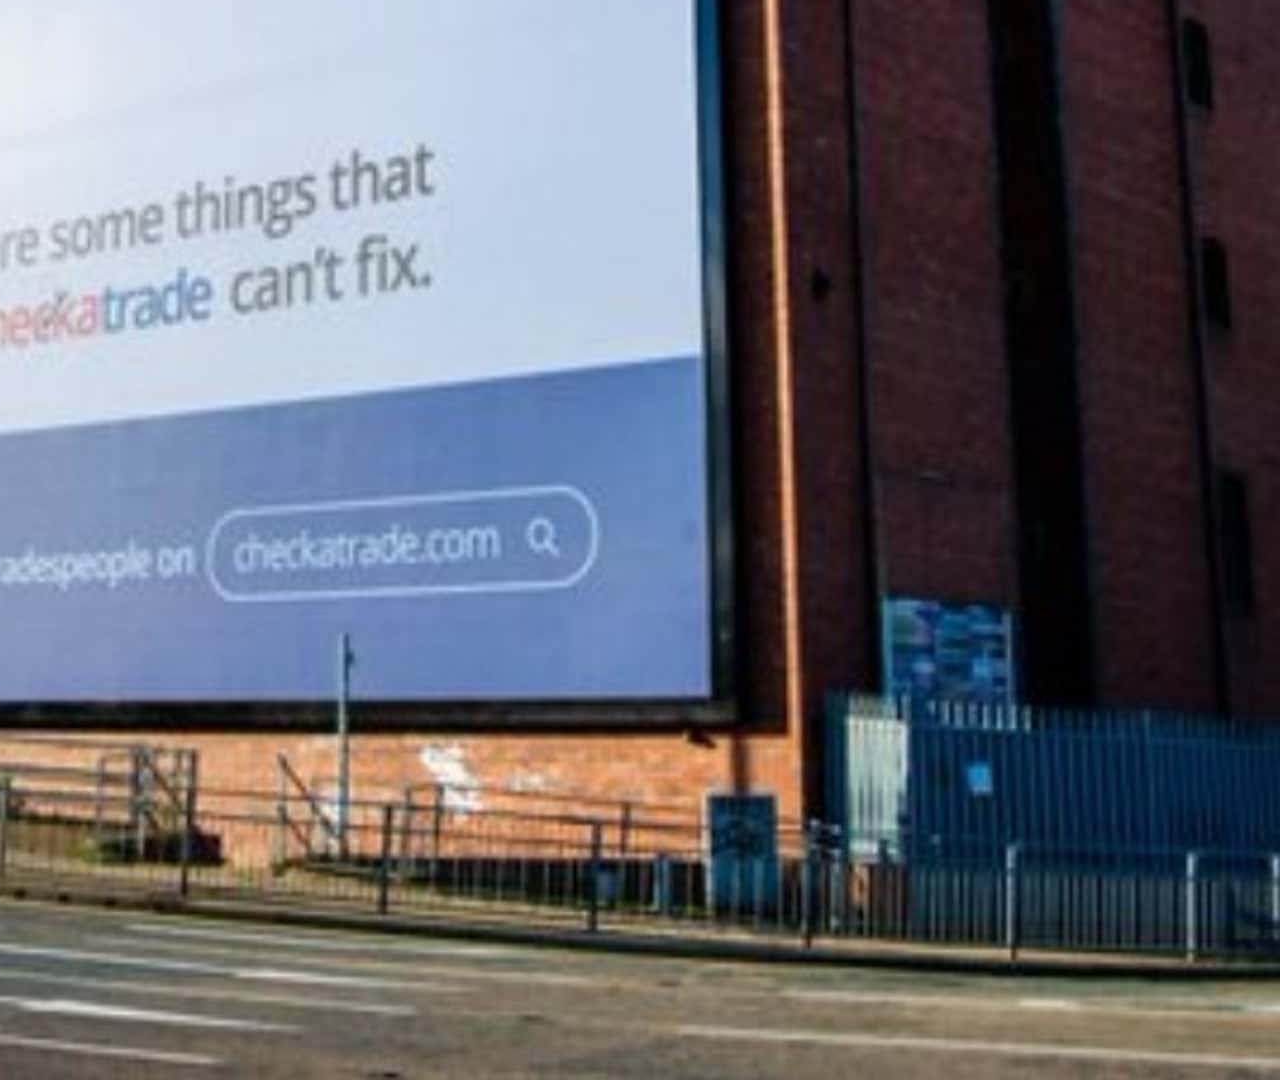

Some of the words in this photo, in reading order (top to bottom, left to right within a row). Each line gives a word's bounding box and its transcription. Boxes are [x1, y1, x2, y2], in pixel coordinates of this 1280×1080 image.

[47, 201, 165, 262] some
[174, 168, 317, 241] things
[329, 142, 435, 212] that
[229, 248, 344, 315] can't
[354, 234, 432, 298] fix.
[156, 546, 195, 579] on
[233, 521, 502, 575] checkatrade.com
